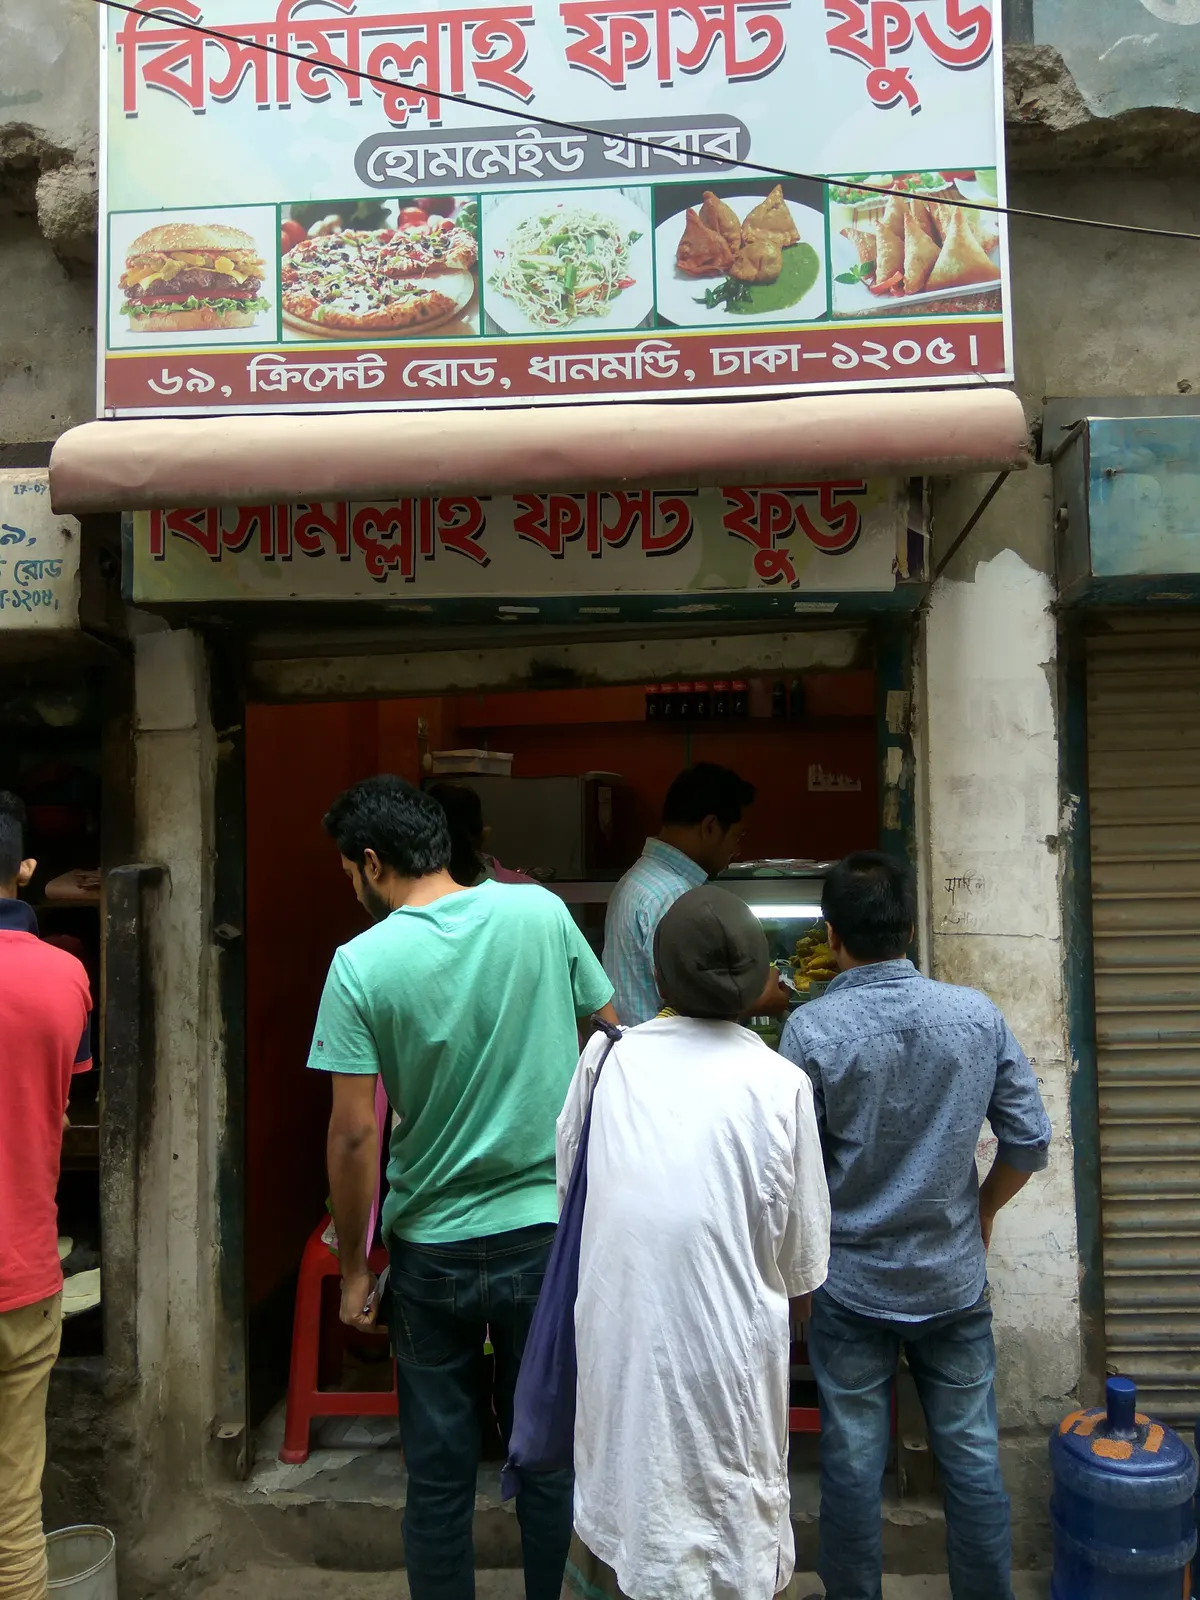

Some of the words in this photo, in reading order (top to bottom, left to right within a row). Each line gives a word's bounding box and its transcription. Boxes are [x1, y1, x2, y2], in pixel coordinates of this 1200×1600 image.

[116, 0, 536, 128] বিসমিল্লাহ
[823, 0, 994, 117] ফুড
[366, 127, 588, 185] হোমমেইড
[602, 126, 741, 170] খাবার
[147, 367, 233, 398] ৬৯,
[246, 353, 388, 393] ক্রিসেন্ট
[402, 357, 511, 391] রোড,
[13, 559, 64, 587] রোড
